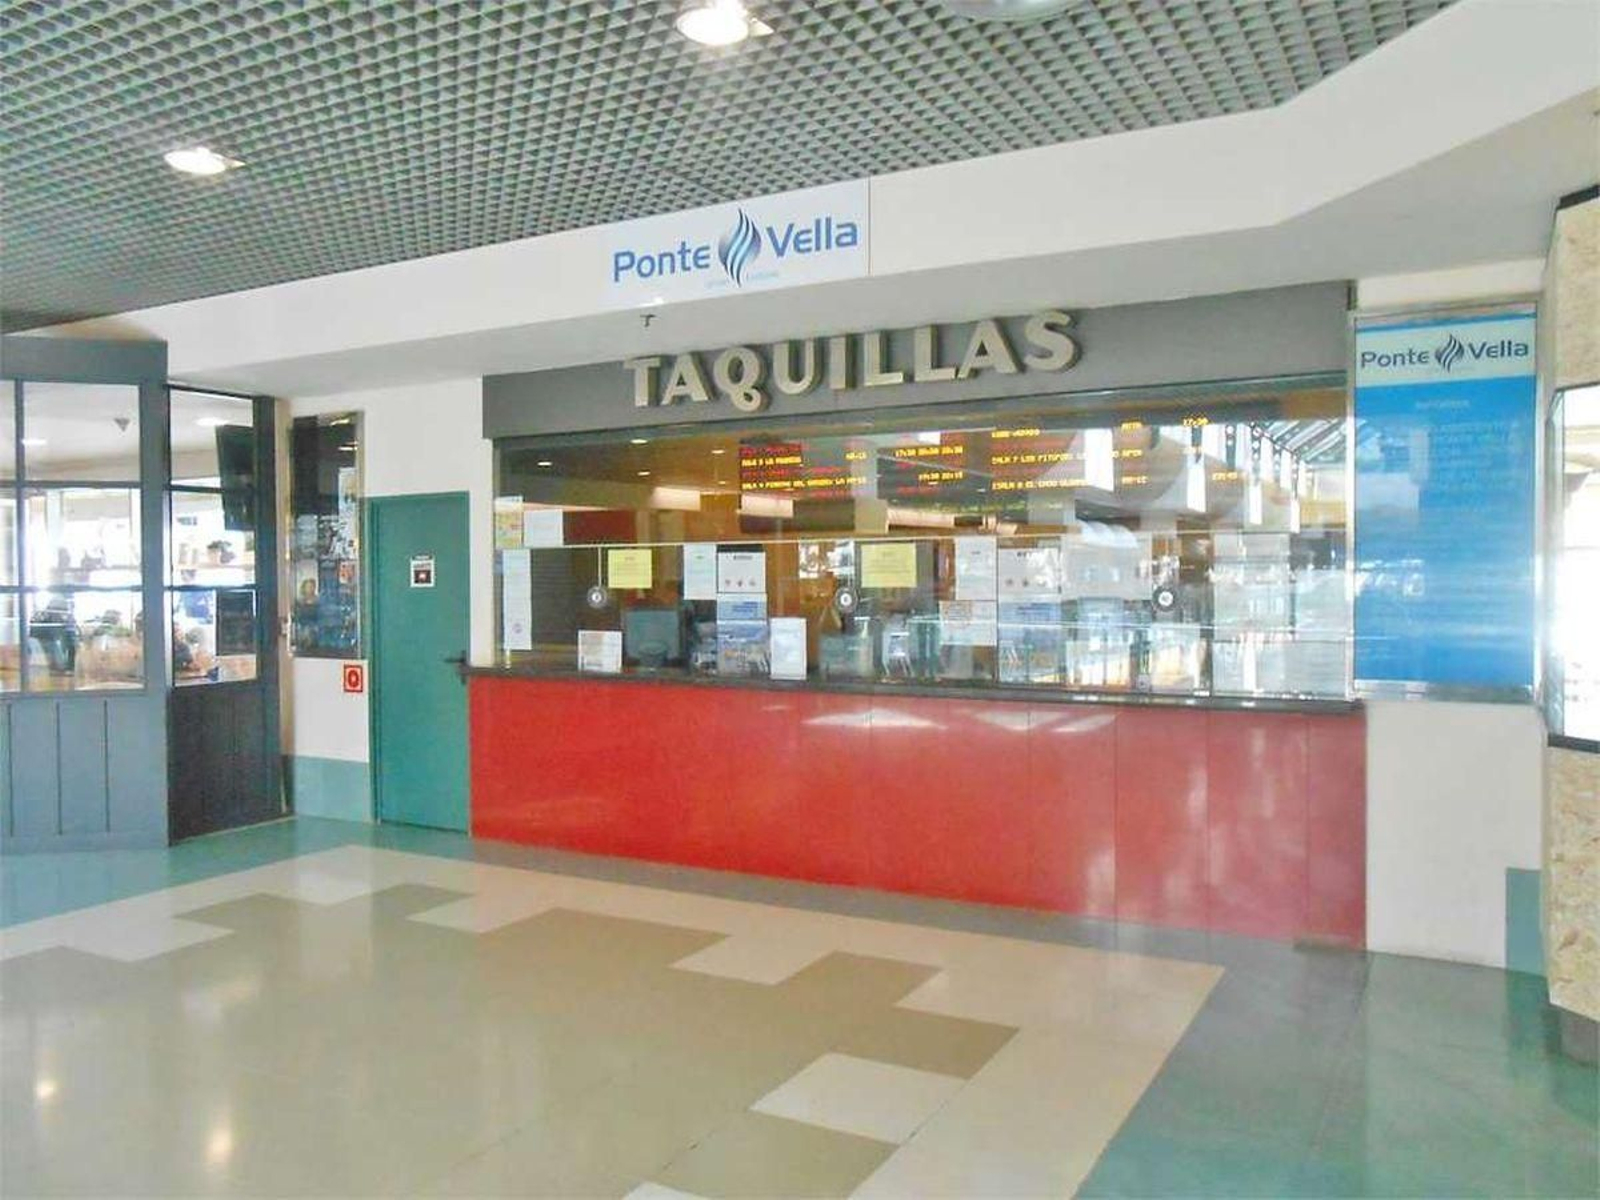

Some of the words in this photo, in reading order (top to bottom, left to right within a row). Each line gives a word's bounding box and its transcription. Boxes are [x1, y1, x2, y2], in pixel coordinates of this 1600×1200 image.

[613, 240, 710, 282] Ponte
[766, 216, 859, 259] Vella
[624, 308, 1082, 413] TAQUILLAS
[1360, 348, 1430, 368] Ponte
[1468, 340, 1529, 359] Vella
